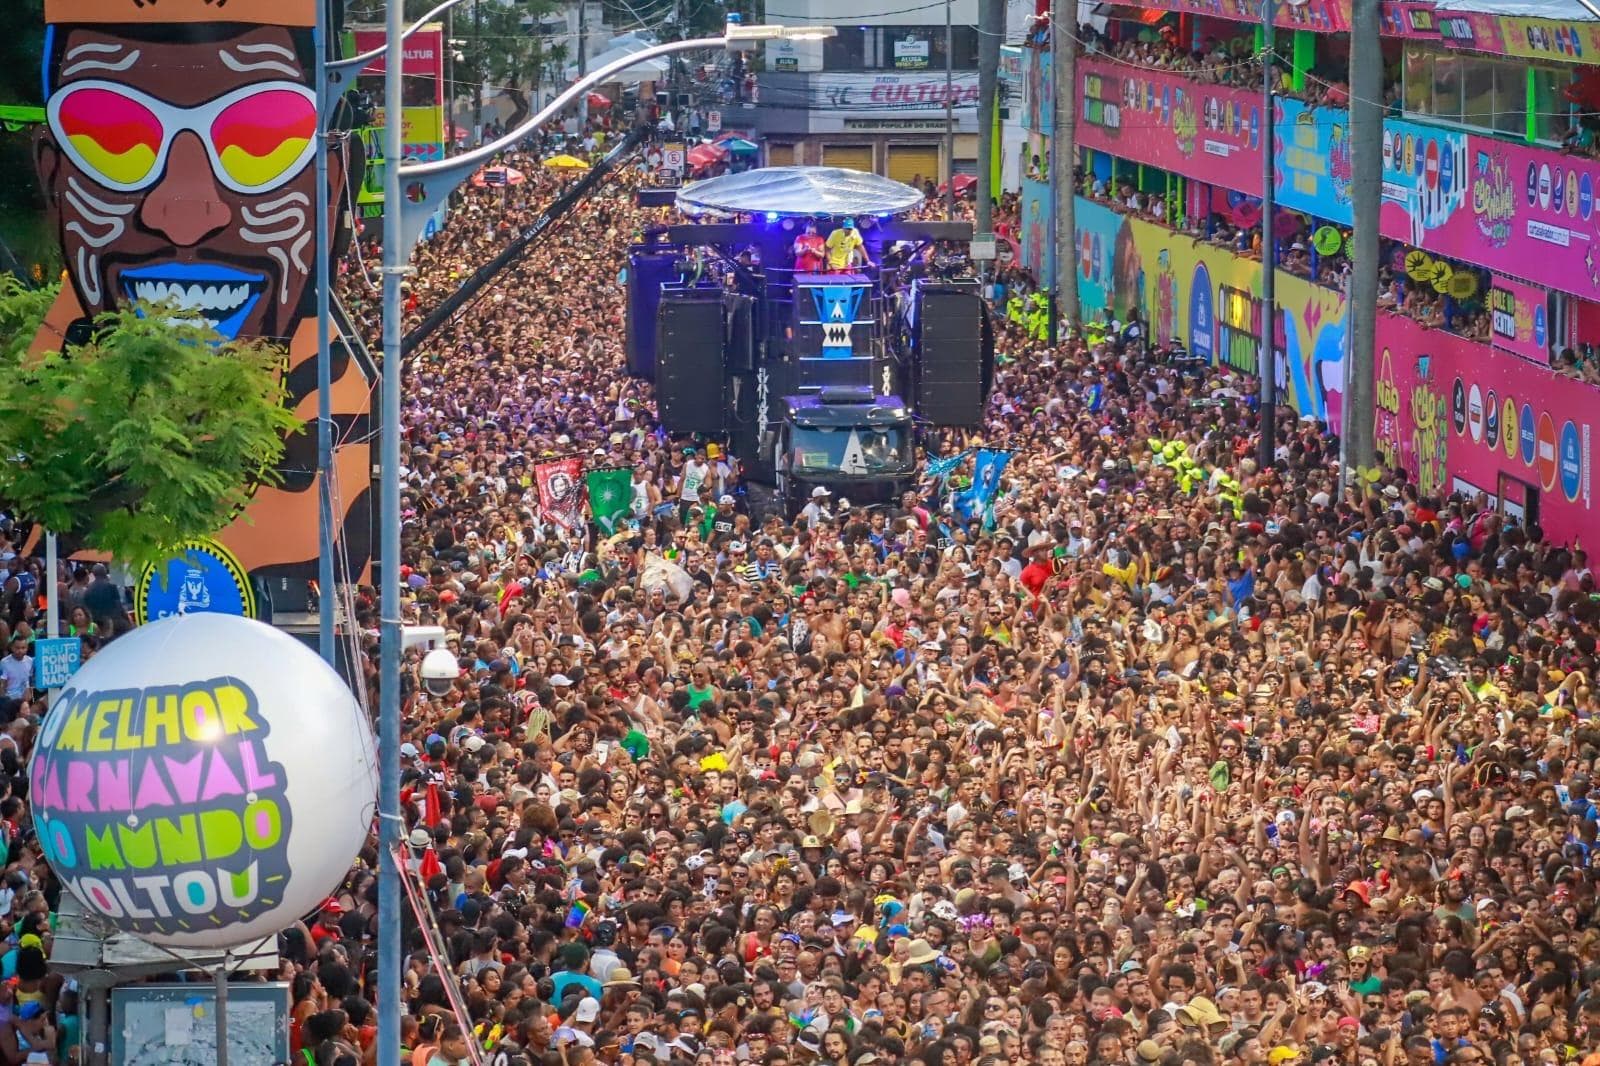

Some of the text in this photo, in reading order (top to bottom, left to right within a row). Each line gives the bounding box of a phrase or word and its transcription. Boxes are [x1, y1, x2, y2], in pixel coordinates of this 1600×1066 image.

[870, 83, 979, 104] CULTURA
[926, 121, 949, 129] BRASI
[1376, 379, 1399, 415] NÃO
[42, 685, 259, 752] O MELHOR
[33, 740, 277, 812] CARNAVAL
[85, 798, 282, 871] MUNDO
[69, 858, 259, 920] VOLTOU
